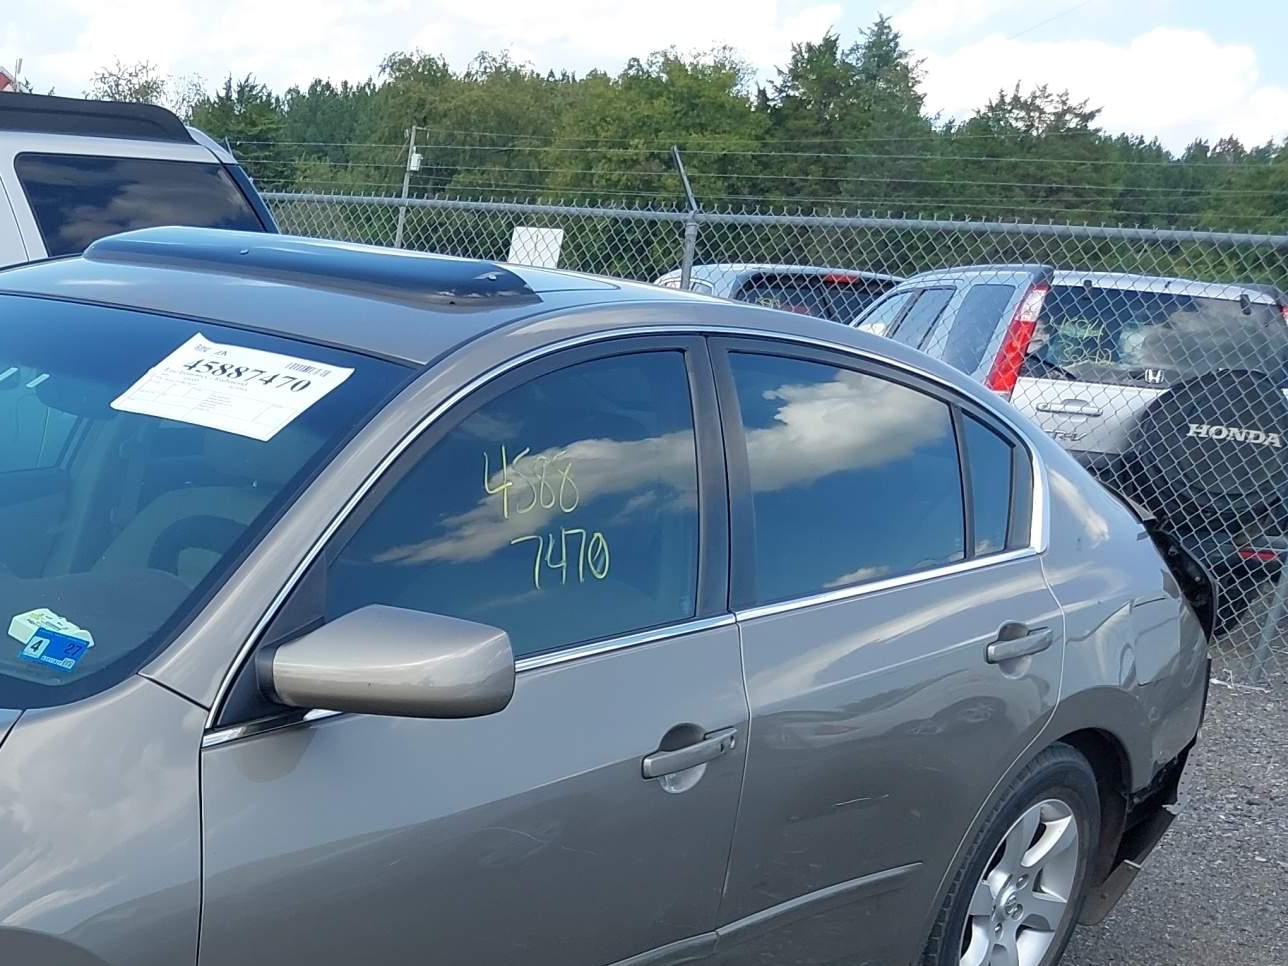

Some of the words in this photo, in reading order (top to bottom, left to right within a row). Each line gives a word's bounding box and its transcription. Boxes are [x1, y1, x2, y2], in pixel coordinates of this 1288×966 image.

[184, 358, 312, 393] 45887470
[1187, 423, 1282, 448] HONDA
[483, 444, 580, 519] 4588
[510, 527, 610, 592] 7470
[30, 639, 44, 653] 4
[64, 643, 83, 657] 27
